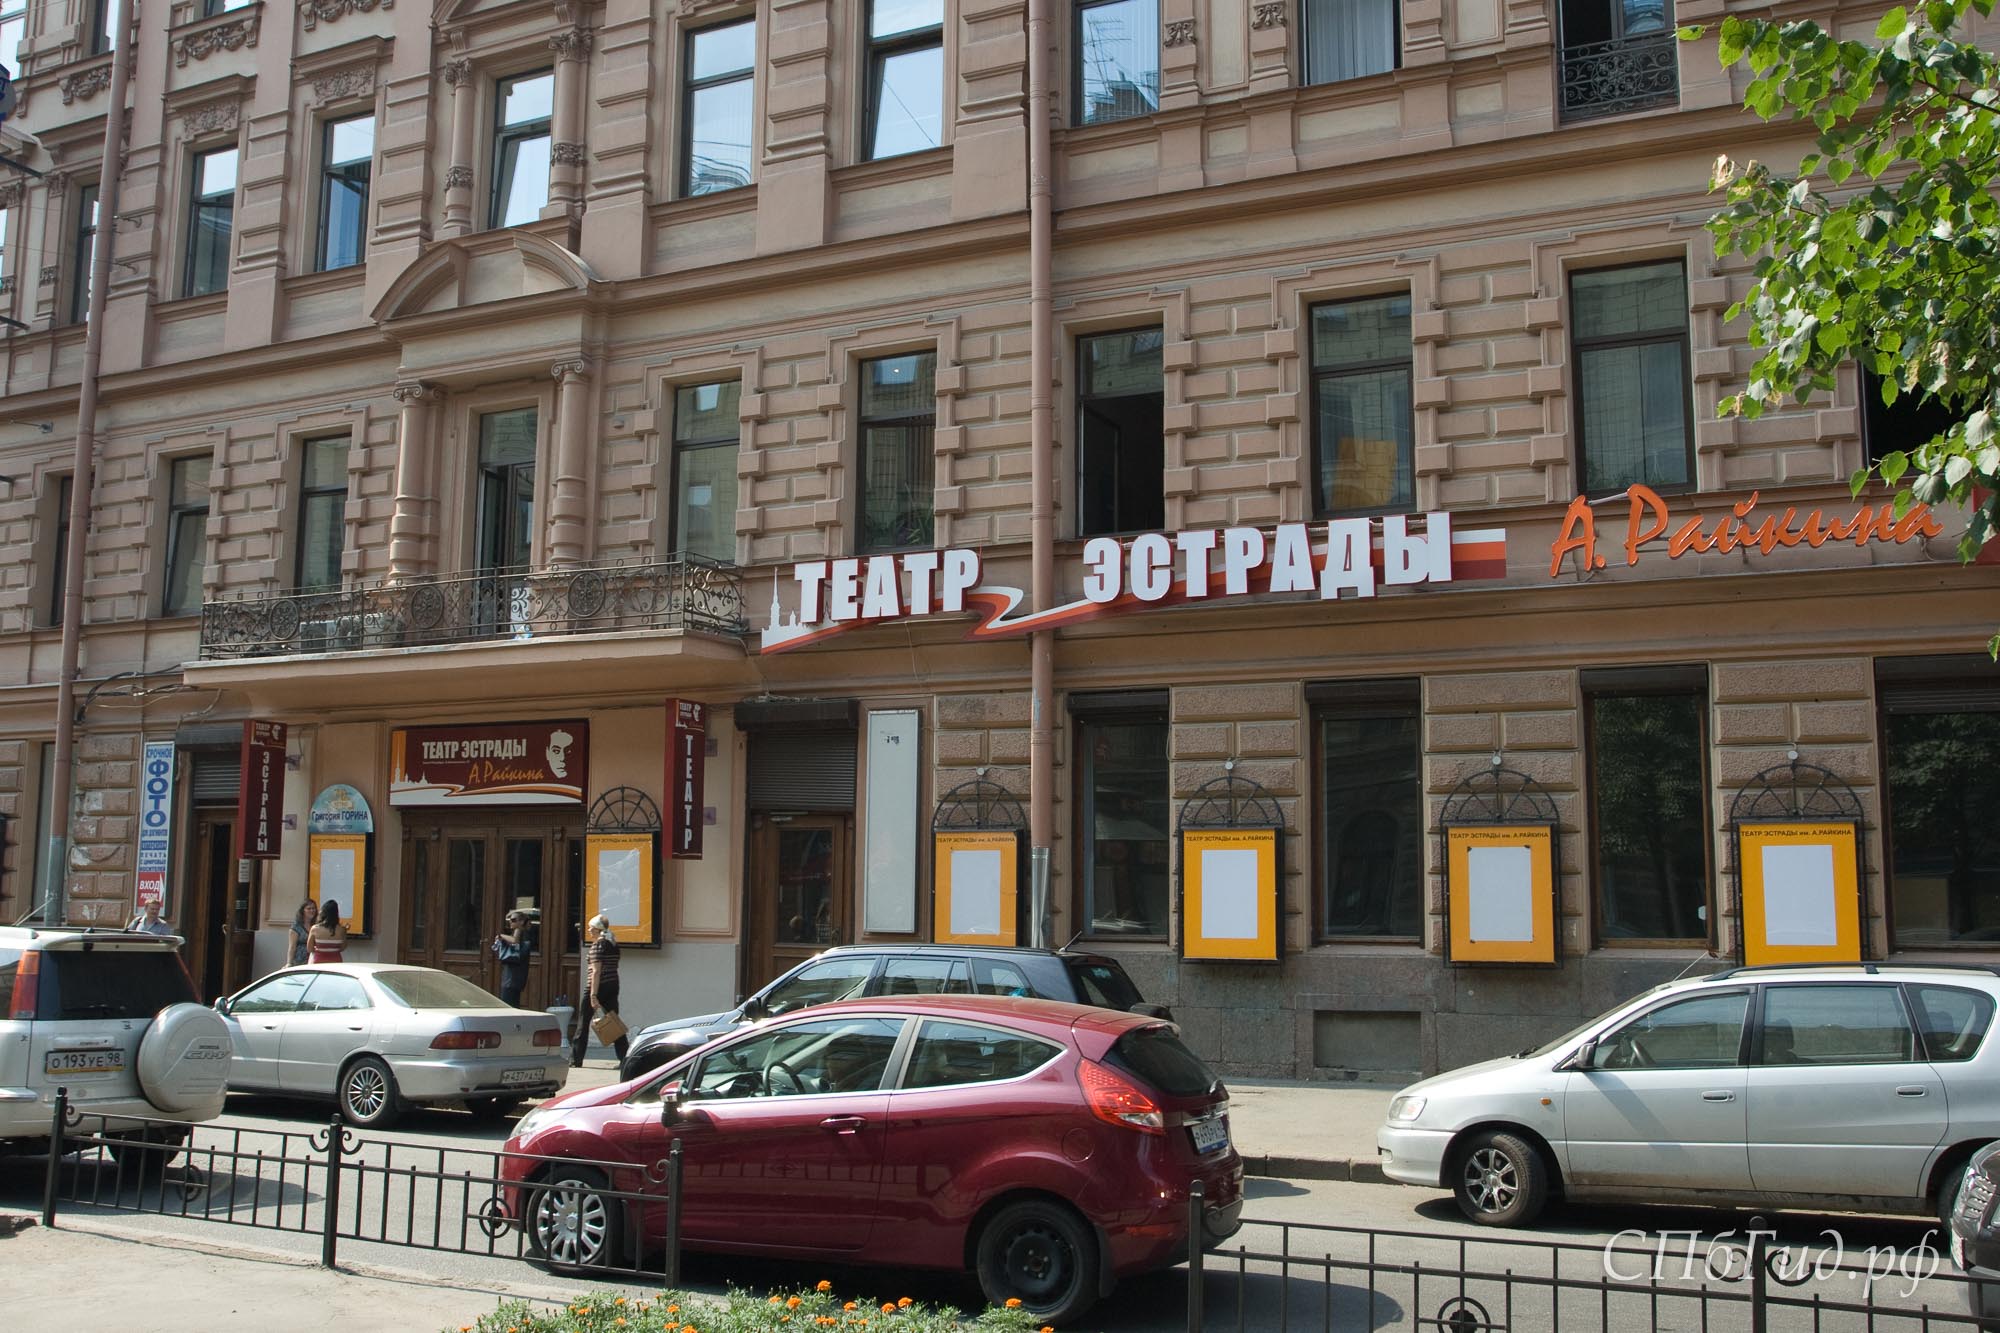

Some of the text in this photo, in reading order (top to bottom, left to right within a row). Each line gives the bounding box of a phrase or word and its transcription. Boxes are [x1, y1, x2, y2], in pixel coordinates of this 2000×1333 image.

[795, 483, 1944, 624] ТЕАТР ЭСТРАДЫ А. Райкина
[422, 739, 527, 760] ТЕАТР ЭСТРАДЫ
[468, 760, 545, 785] А. Райкина
[145, 759, 170, 827] ФОТО
[257, 751, 270, 851] ЭСТРАДЫ
[341, 810, 369, 821] ГОРИНА
[684, 735, 693, 850] ТЕАТР
[139, 880, 160, 892] ВХОД
